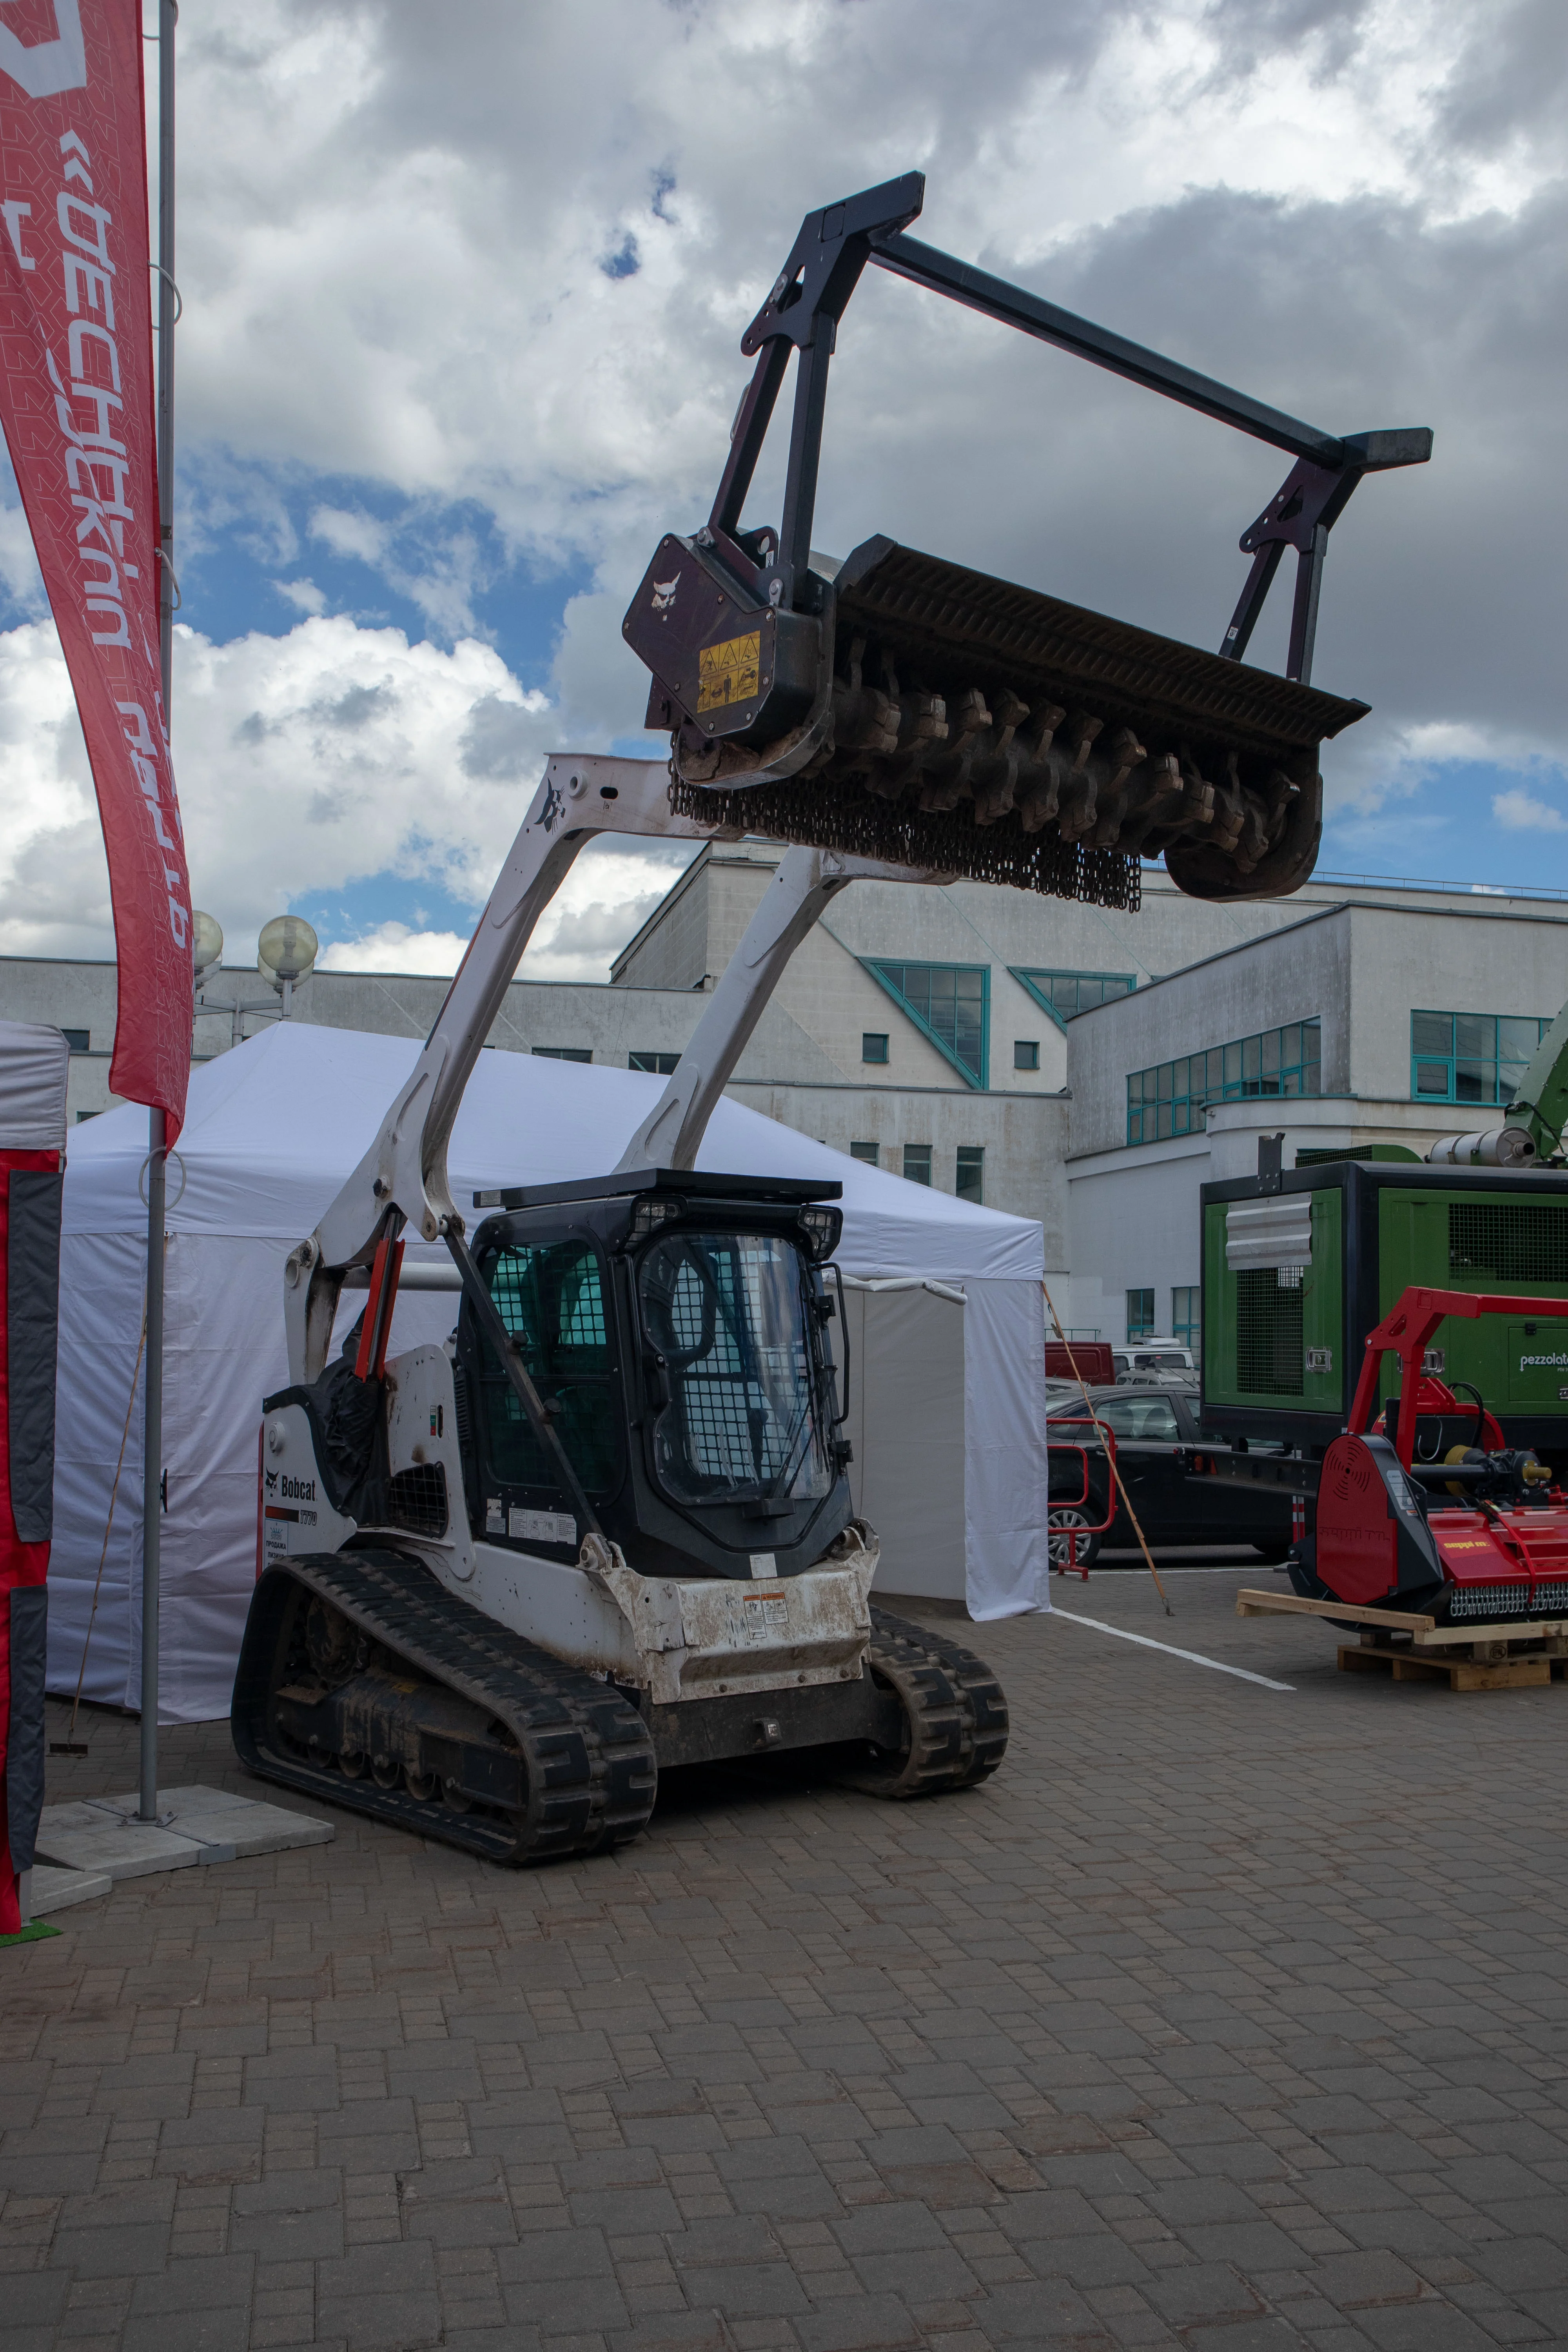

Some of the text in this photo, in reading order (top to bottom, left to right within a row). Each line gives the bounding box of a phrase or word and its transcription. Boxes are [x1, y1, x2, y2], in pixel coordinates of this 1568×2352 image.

[1519, 1352, 1568, 1372] pezzolat
[281, 1475, 316, 1501] Bobcat
[300, 1510, 318, 1526] T770
[266, 1541, 286, 1550] ПРОДАЖА
